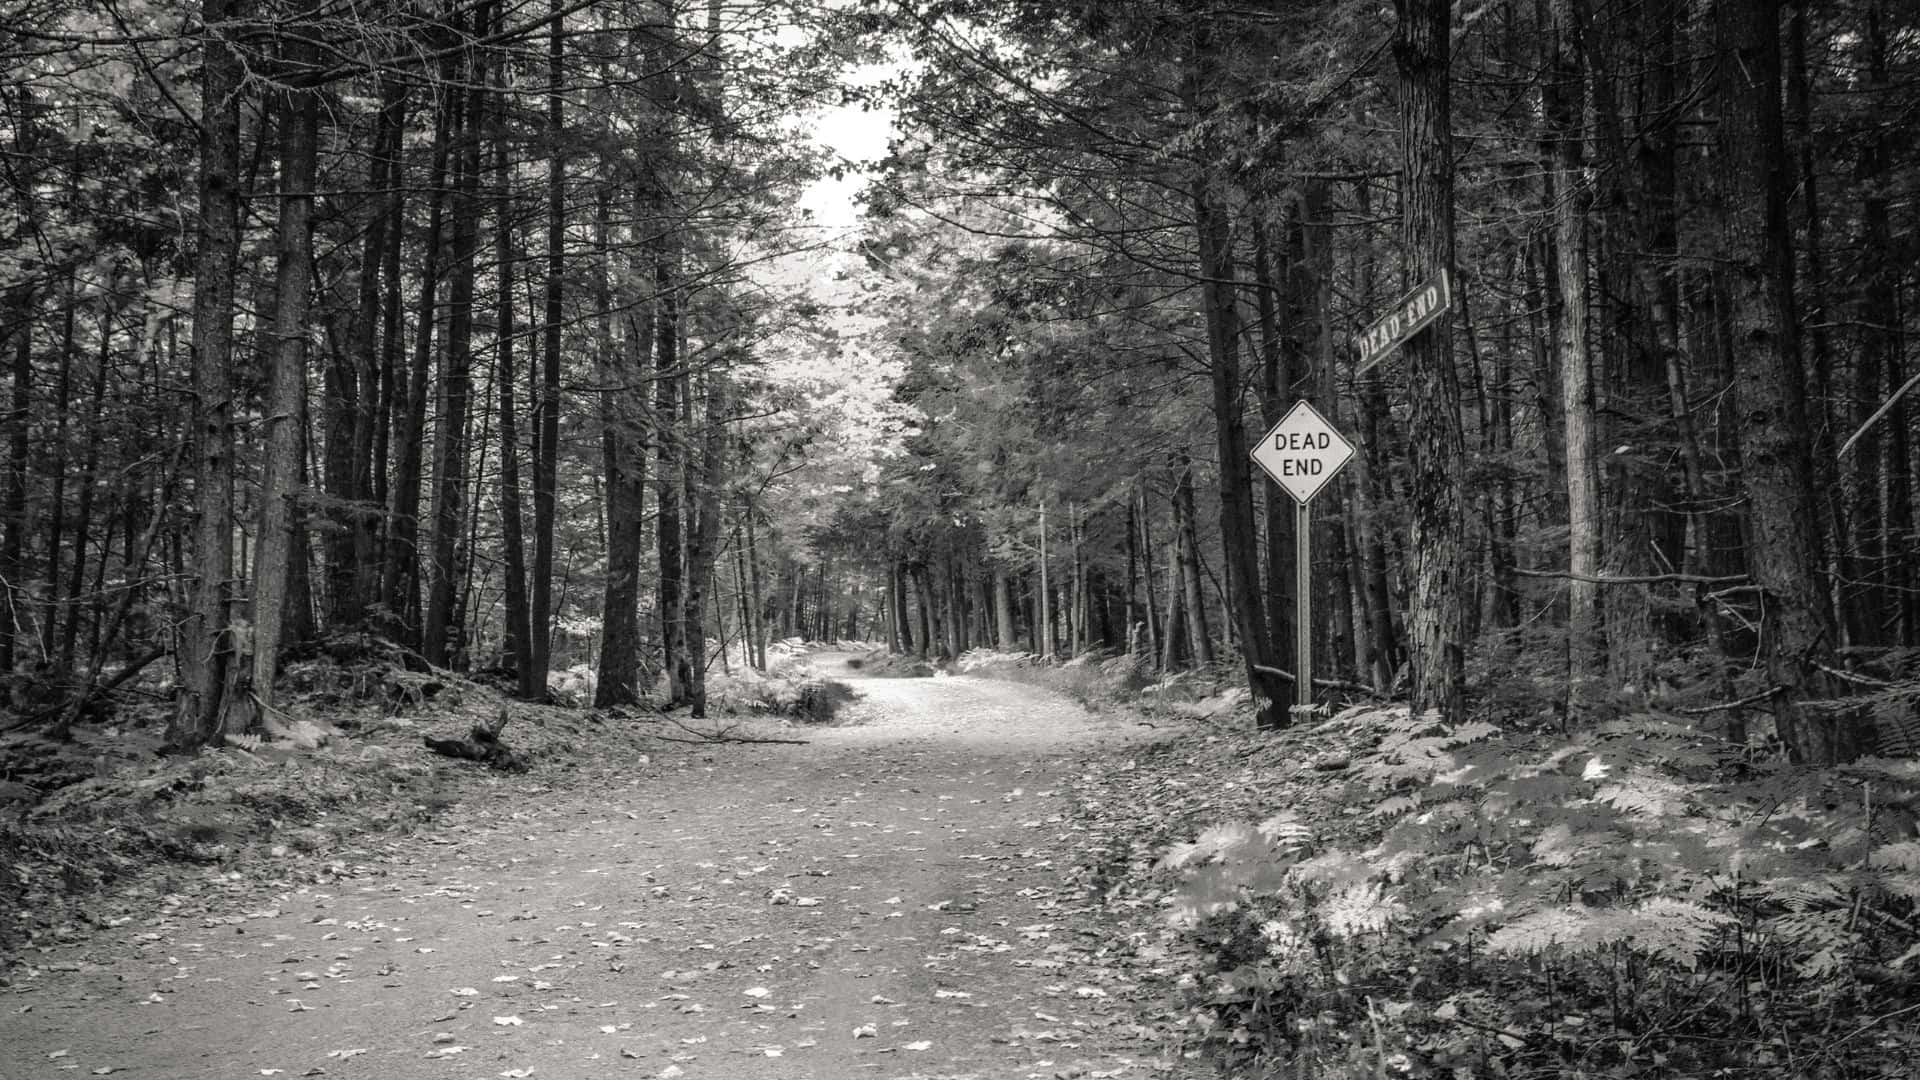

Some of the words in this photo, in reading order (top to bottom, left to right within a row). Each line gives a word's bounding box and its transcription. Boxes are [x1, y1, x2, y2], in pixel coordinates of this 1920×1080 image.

[1360, 315, 1399, 361] DEAD
[1408, 286, 1437, 326] END
[1275, 432, 1330, 450] DEAD
[1283, 458, 1322, 476] END
